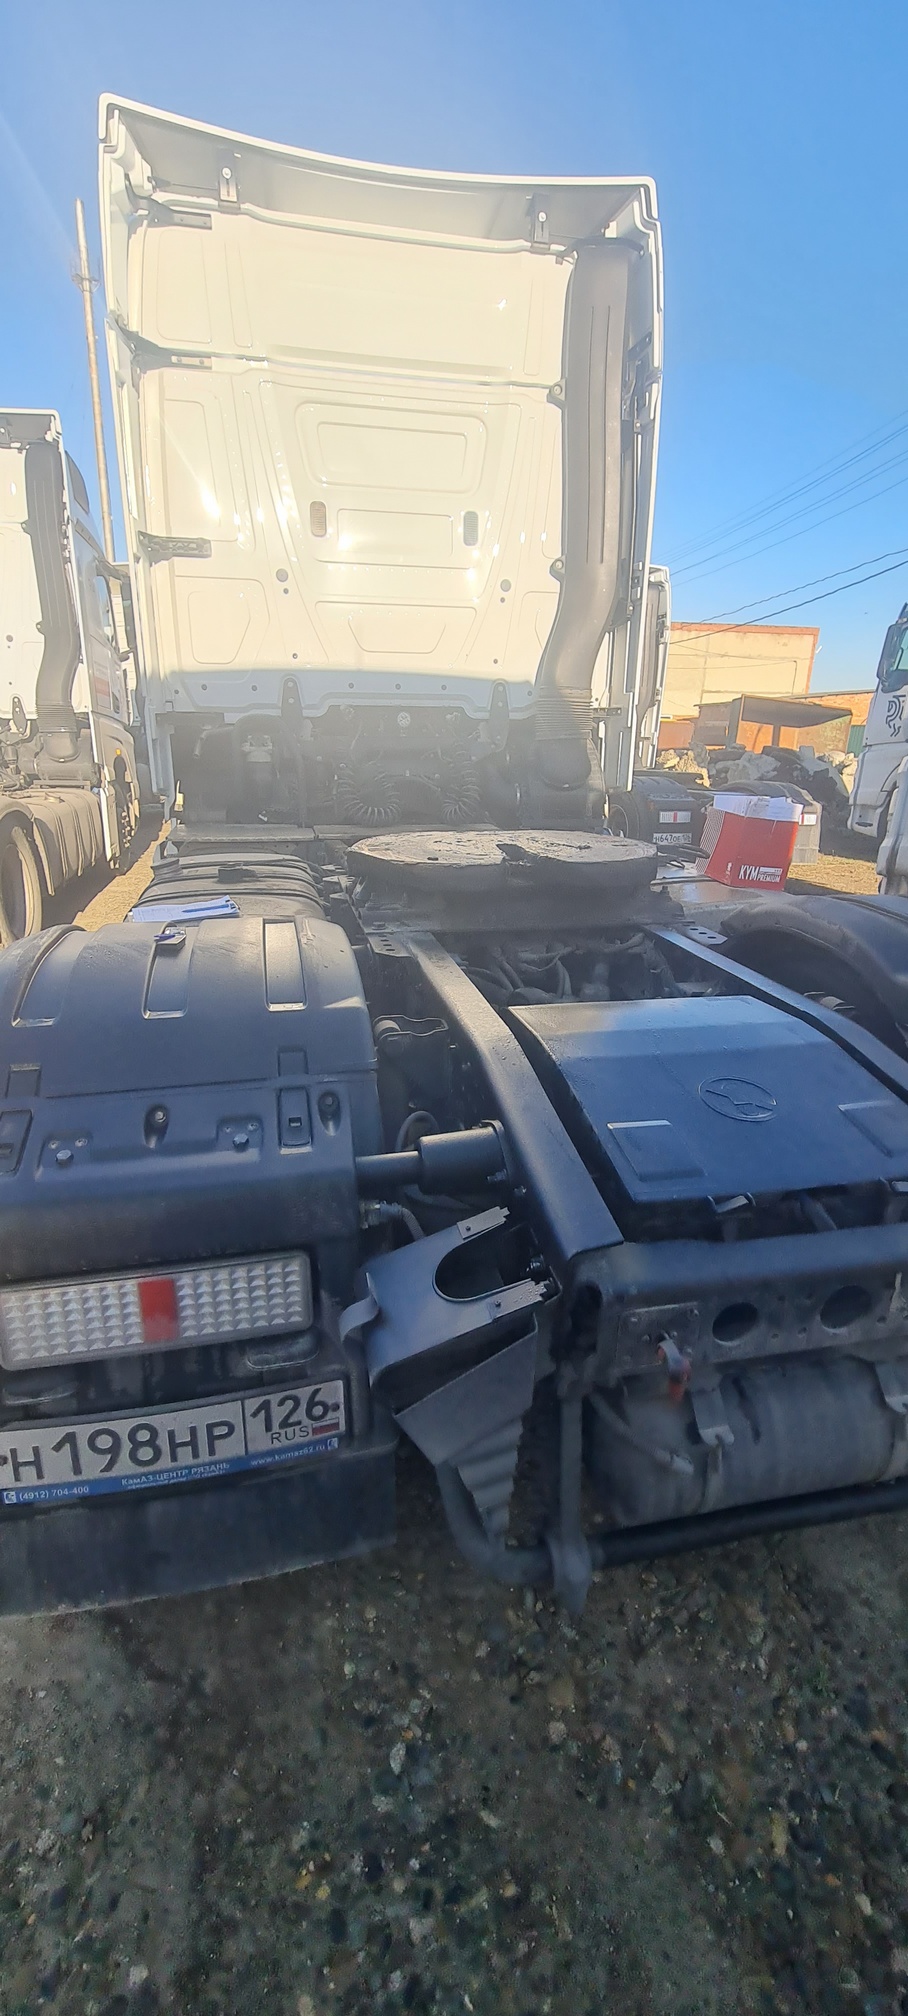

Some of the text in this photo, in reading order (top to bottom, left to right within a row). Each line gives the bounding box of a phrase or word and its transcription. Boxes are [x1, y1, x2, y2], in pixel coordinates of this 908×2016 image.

[739, 864, 760, 881] KYM
[9, 1387, 330, 1482] Н198НР 126
[271, 1426, 310, 1445] RUS
[251, 1445, 326, 1466] www.kamaz62.ru
[191, 1462, 230, 1475] РЯЗАНЬ
[19, 1486, 89, 1501] (4912) 704-400
